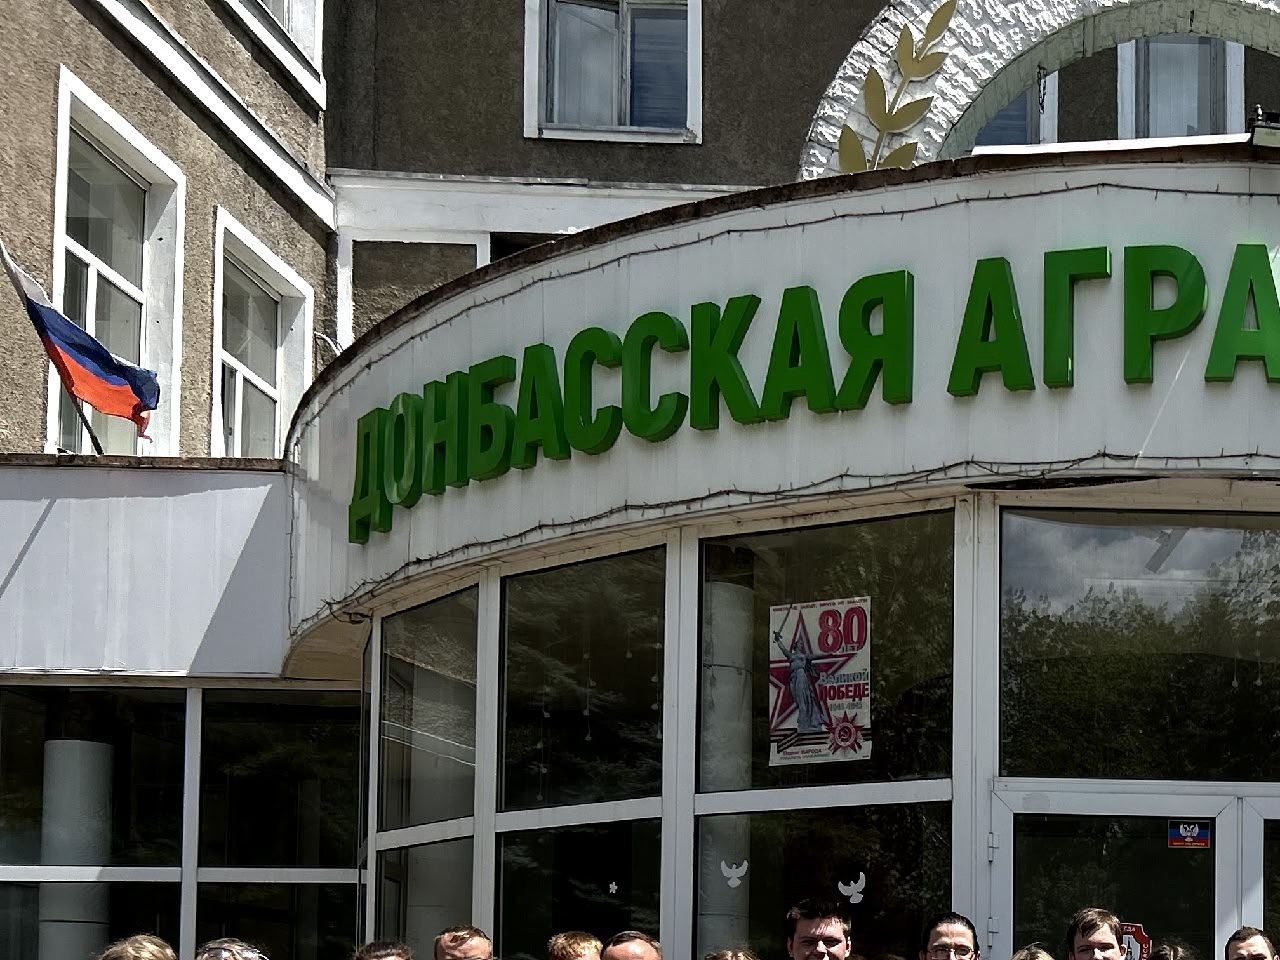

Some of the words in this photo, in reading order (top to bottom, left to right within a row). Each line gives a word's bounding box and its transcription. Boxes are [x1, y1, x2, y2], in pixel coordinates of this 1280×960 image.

[348, 268, 915, 545] ДОНБАССКАЯ
[818, 605, 868, 653] 80
[819, 683, 870, 702] ПОБЕДЕ
